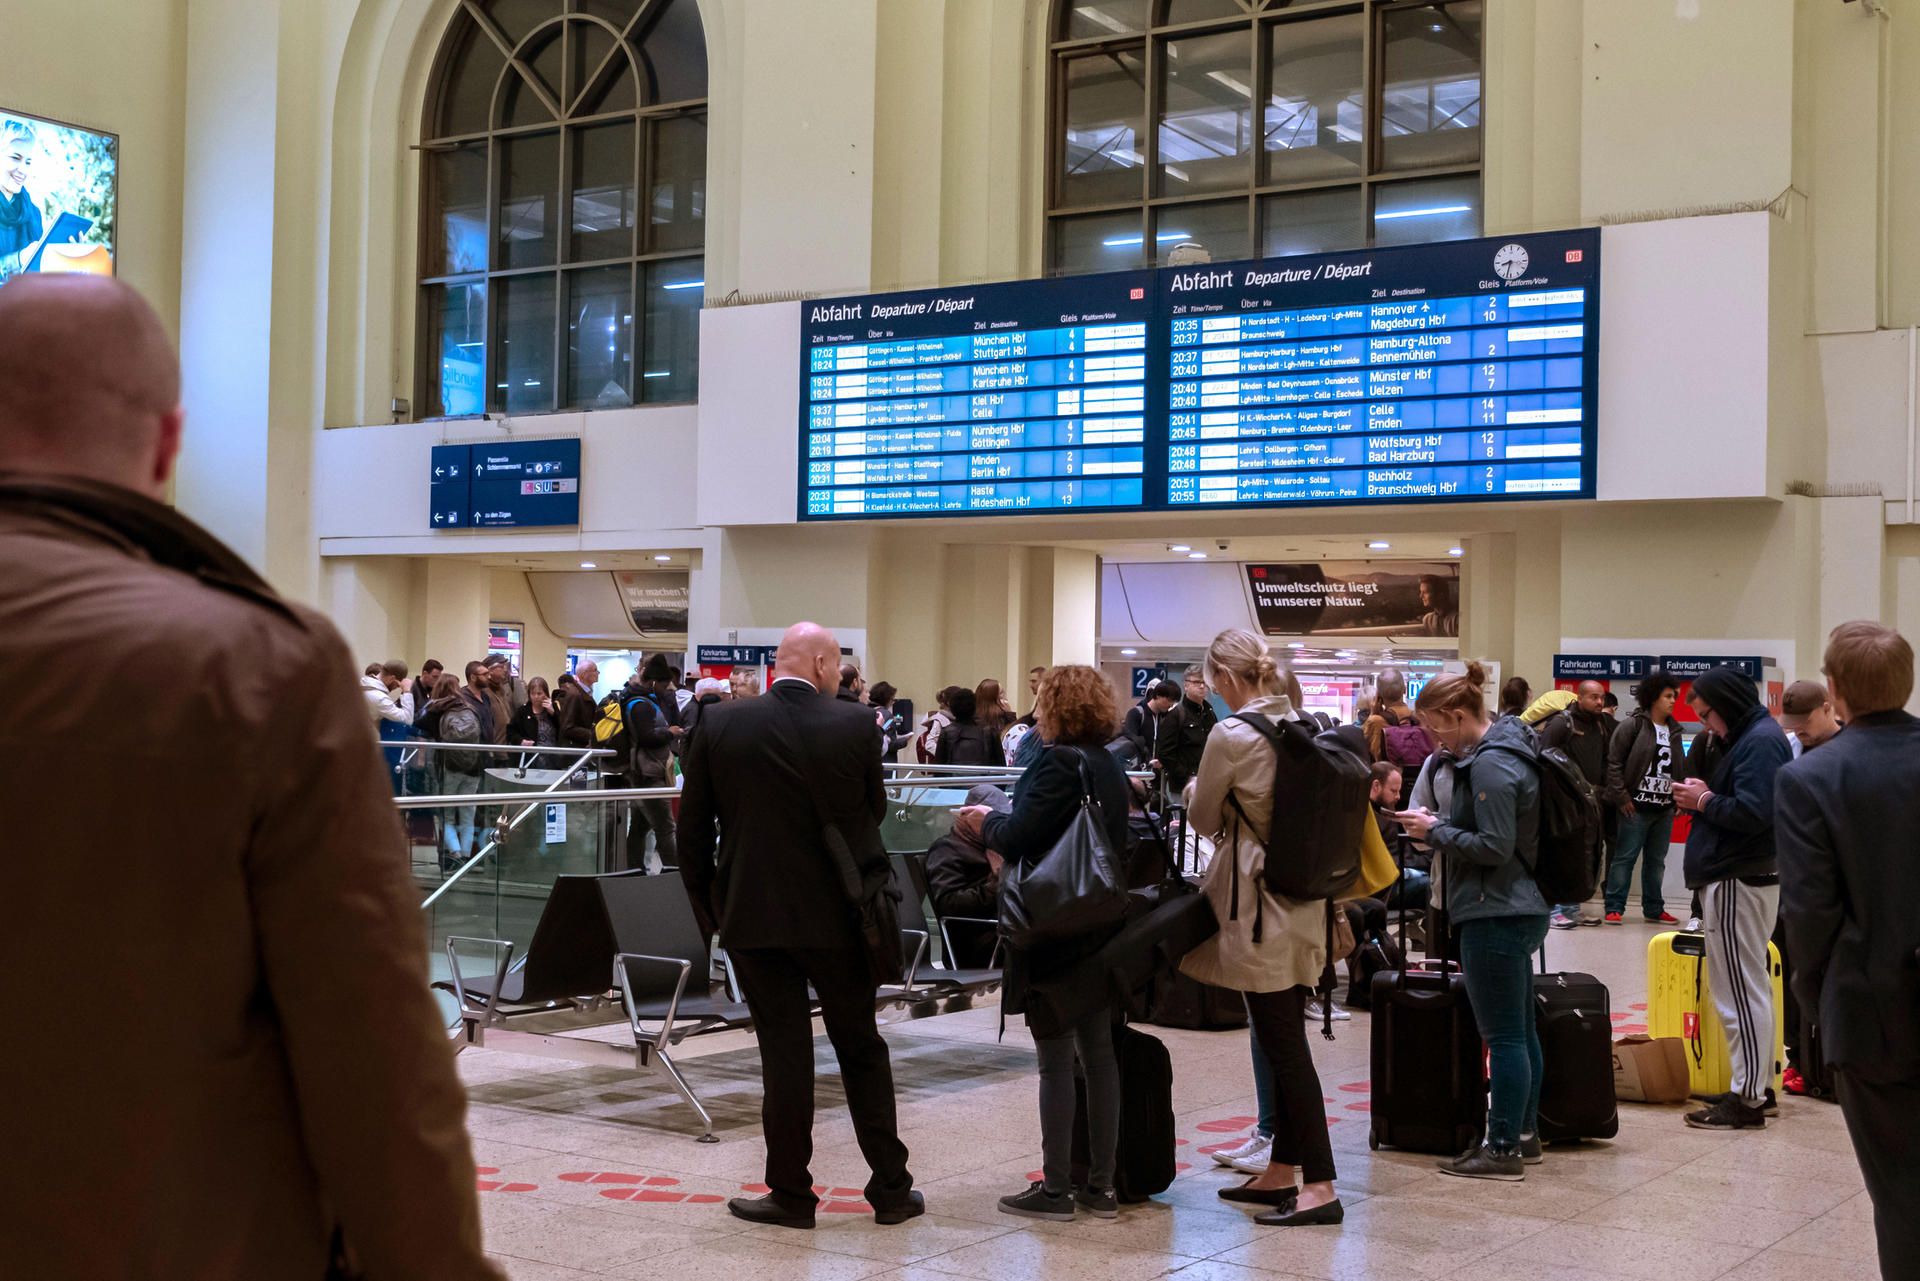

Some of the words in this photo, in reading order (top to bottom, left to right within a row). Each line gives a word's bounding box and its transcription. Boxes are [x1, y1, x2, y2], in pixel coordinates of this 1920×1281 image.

[1566, 251, 1582, 262] DB
[1171, 271, 1233, 291] Abfahrt
[1244, 269, 1311, 286] Departure
[1324, 261, 1372, 280] Départ
[1173, 306, 1186, 314] Zeit
[1242, 299, 1258, 308] Über
[1372, 290, 1386, 298] Ziel
[1479, 280, 1500, 289] Gleis
[811, 304, 862, 323] Abfahrt
[871, 302, 925, 319] Departure
[935, 297, 974, 313] Départ
[1173, 320, 1197, 332] 20:35
[1371, 305, 1417, 315] Hannover
[1490, 298, 1496, 307] 2
[812, 335, 824, 343] Zeit
[868, 330, 883, 338] Über
[974, 322, 986, 330] Ziel
[1061, 314, 1078, 322] Gleis
[1173, 333, 1197, 344] 20:37
[1371, 318, 1426, 331] Magdeburg
[1429, 315, 1446, 325] Hbf
[1483, 311, 1496, 322] 10
[814, 349, 833, 358] 17:02
[973, 334, 1009, 346] München
[1012, 333, 1026, 343] Hbf
[1069, 330, 1075, 339] 4
[974, 346, 1010, 359] Stuttgart
[1013, 346, 1026, 356] Hbf
[1069, 342, 1075, 351] 4
[1173, 352, 1197, 363] 20:37
[1371, 335, 1451, 350] Hamburg-Altona
[1173, 365, 1196, 376] 20:40
[1370, 350, 1436, 363] Bennemühlen
[1489, 345, 1495, 355] 2
[813, 377, 832, 386] 19:02
[973, 364, 1009, 376] München
[1012, 364, 1025, 374] Hbf
[1068, 360, 1074, 369] 4
[973, 376, 1012, 389] Karlsruhe
[1015, 375, 1028, 385] Hbf
[1068, 372, 1074, 382] 4
[1172, 383, 1196, 395] 20:40
[1370, 371, 1410, 382] Münster
[1414, 368, 1432, 379] Hbf
[1482, 365, 1495, 375] 12
[972, 395, 987, 405] Kiel
[990, 394, 1004, 404] Hbf
[1172, 396, 1196, 407] 20:40
[1369, 385, 1403, 396] Uelzen
[1488, 379, 1494, 389] 7
[972, 408, 992, 418] Celle
[1172, 414, 1196, 425] 20:41
[1369, 405, 1394, 415] Celle
[1482, 399, 1494, 409] 14
[972, 424, 1008, 437] Nürnberg
[1011, 423, 1024, 433] Hbf
[1068, 421, 1073, 431] 4
[1171, 427, 1196, 438] 20:45
[1369, 419, 1402, 429] Emden
[1483, 413, 1495, 423] 11
[972, 436, 1009, 449] Göttingen
[1068, 434, 1072, 443] 7
[1171, 446, 1195, 457] 20:48
[1369, 436, 1422, 449] Wolfsburg
[1425, 435, 1443, 446] Hbf
[1482, 433, 1494, 443] 12
[972, 455, 1000, 466] Minden
[1067, 452, 1072, 461] 2
[1171, 459, 1195, 470] 20:48
[1369, 451, 1388, 462] Bad
[1390, 449, 1434, 463] Harzburg
[1487, 447, 1494, 457] 8
[971, 467, 994, 478] Berlin
[997, 466, 1011, 476] Hbf
[1067, 464, 1072, 474] 9
[1171, 477, 1195, 488] 20:51
[1368, 470, 1412, 482] Buchholz
[1487, 467, 1493, 477] 2
[544, 482, 549, 492] U
[971, 485, 994, 495] Haste
[1068, 483, 1072, 492] 1
[1171, 490, 1194, 501] 20:55
[1368, 482, 1436, 495] Braunschweig
[1440, 481, 1457, 493] Hbf
[1487, 481, 1493, 491] 9
[971, 496, 1013, 508] Hildesheim
[1016, 496, 1030, 506] Hbf
[1062, 495, 1072, 505] 13
[681, 588, 689, 596] T
[1256, 582, 1345, 593] Umweltschutz
[1348, 582, 1378, 595] liegt
[1259, 596, 1271, 607] in
[1274, 597, 1322, 607] unserer
[1325, 596, 1365, 607] Natur.
[1560, 660, 1601, 668] Fahrkarten
[1666, 661, 1711, 670] Fahrkarten
[1136, 669, 1148, 689] 2
